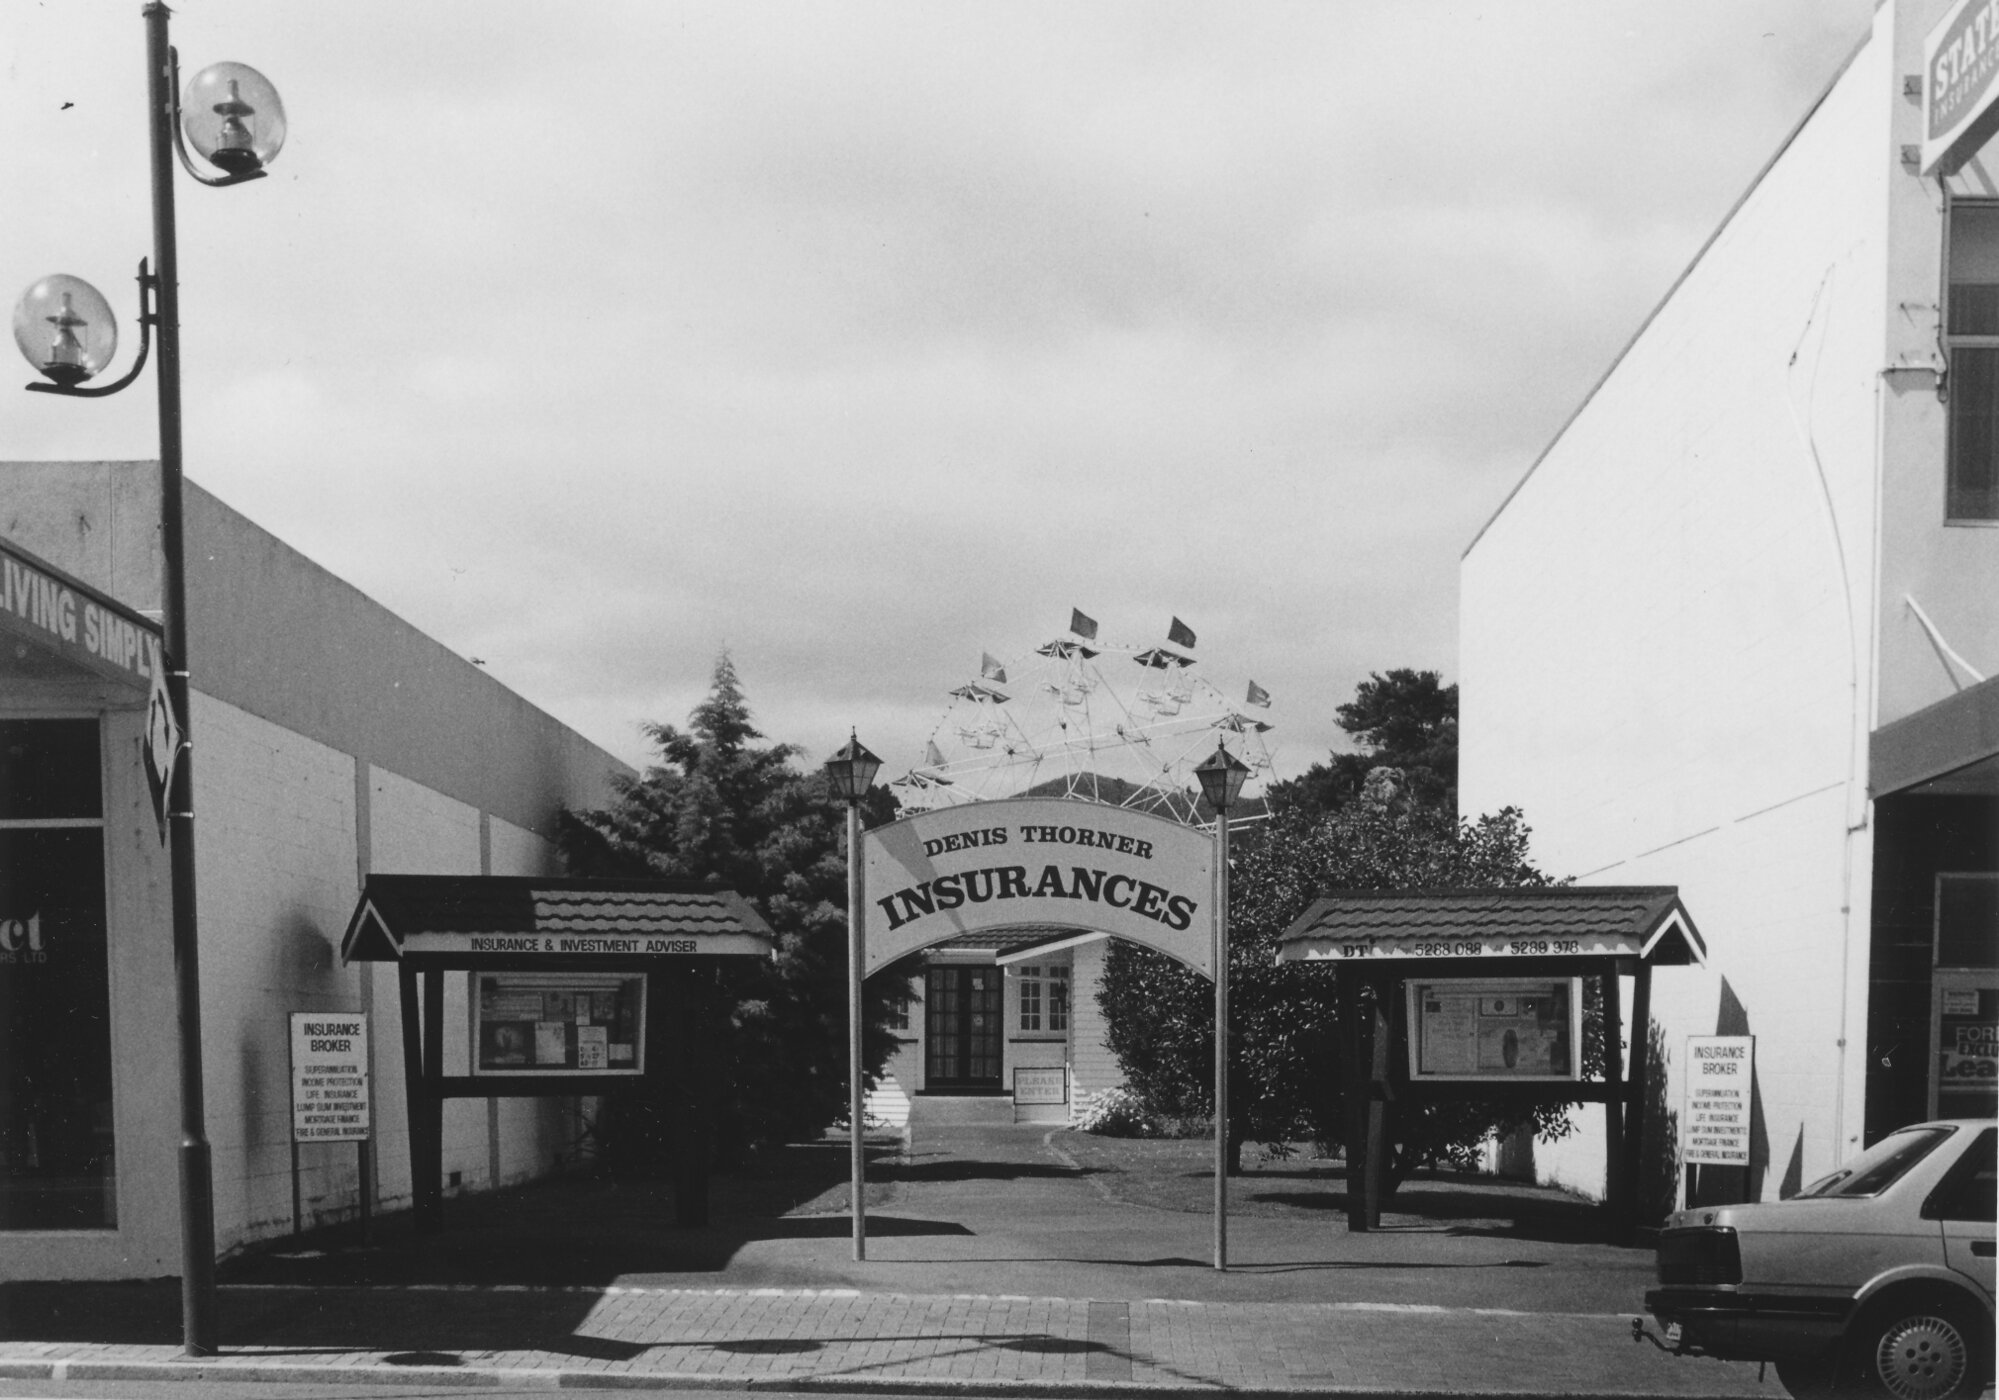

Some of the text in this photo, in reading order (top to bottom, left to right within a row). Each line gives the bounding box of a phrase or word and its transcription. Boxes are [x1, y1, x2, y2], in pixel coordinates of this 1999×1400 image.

[923, 825, 1153, 859] DENIS THORNER
[877, 865, 1198, 931] INSURANCES
[0, 908, 46, 951] ct
[471, 938, 698, 953] INSURANCE & INVESTMENT ADVISER
[23, 951, 48, 964] LTD
[303, 1023, 361, 1036] INSURANCE
[1956, 1026, 1998, 1041] FOR
[310, 1039, 352, 1053] BROKER
[1693, 1046, 1746, 1060] INSURANCE
[1960, 1041, 1998, 1058] EXCLU
[1702, 1062, 1738, 1076] BROKER
[1939, 1053, 1998, 1079] Lea
